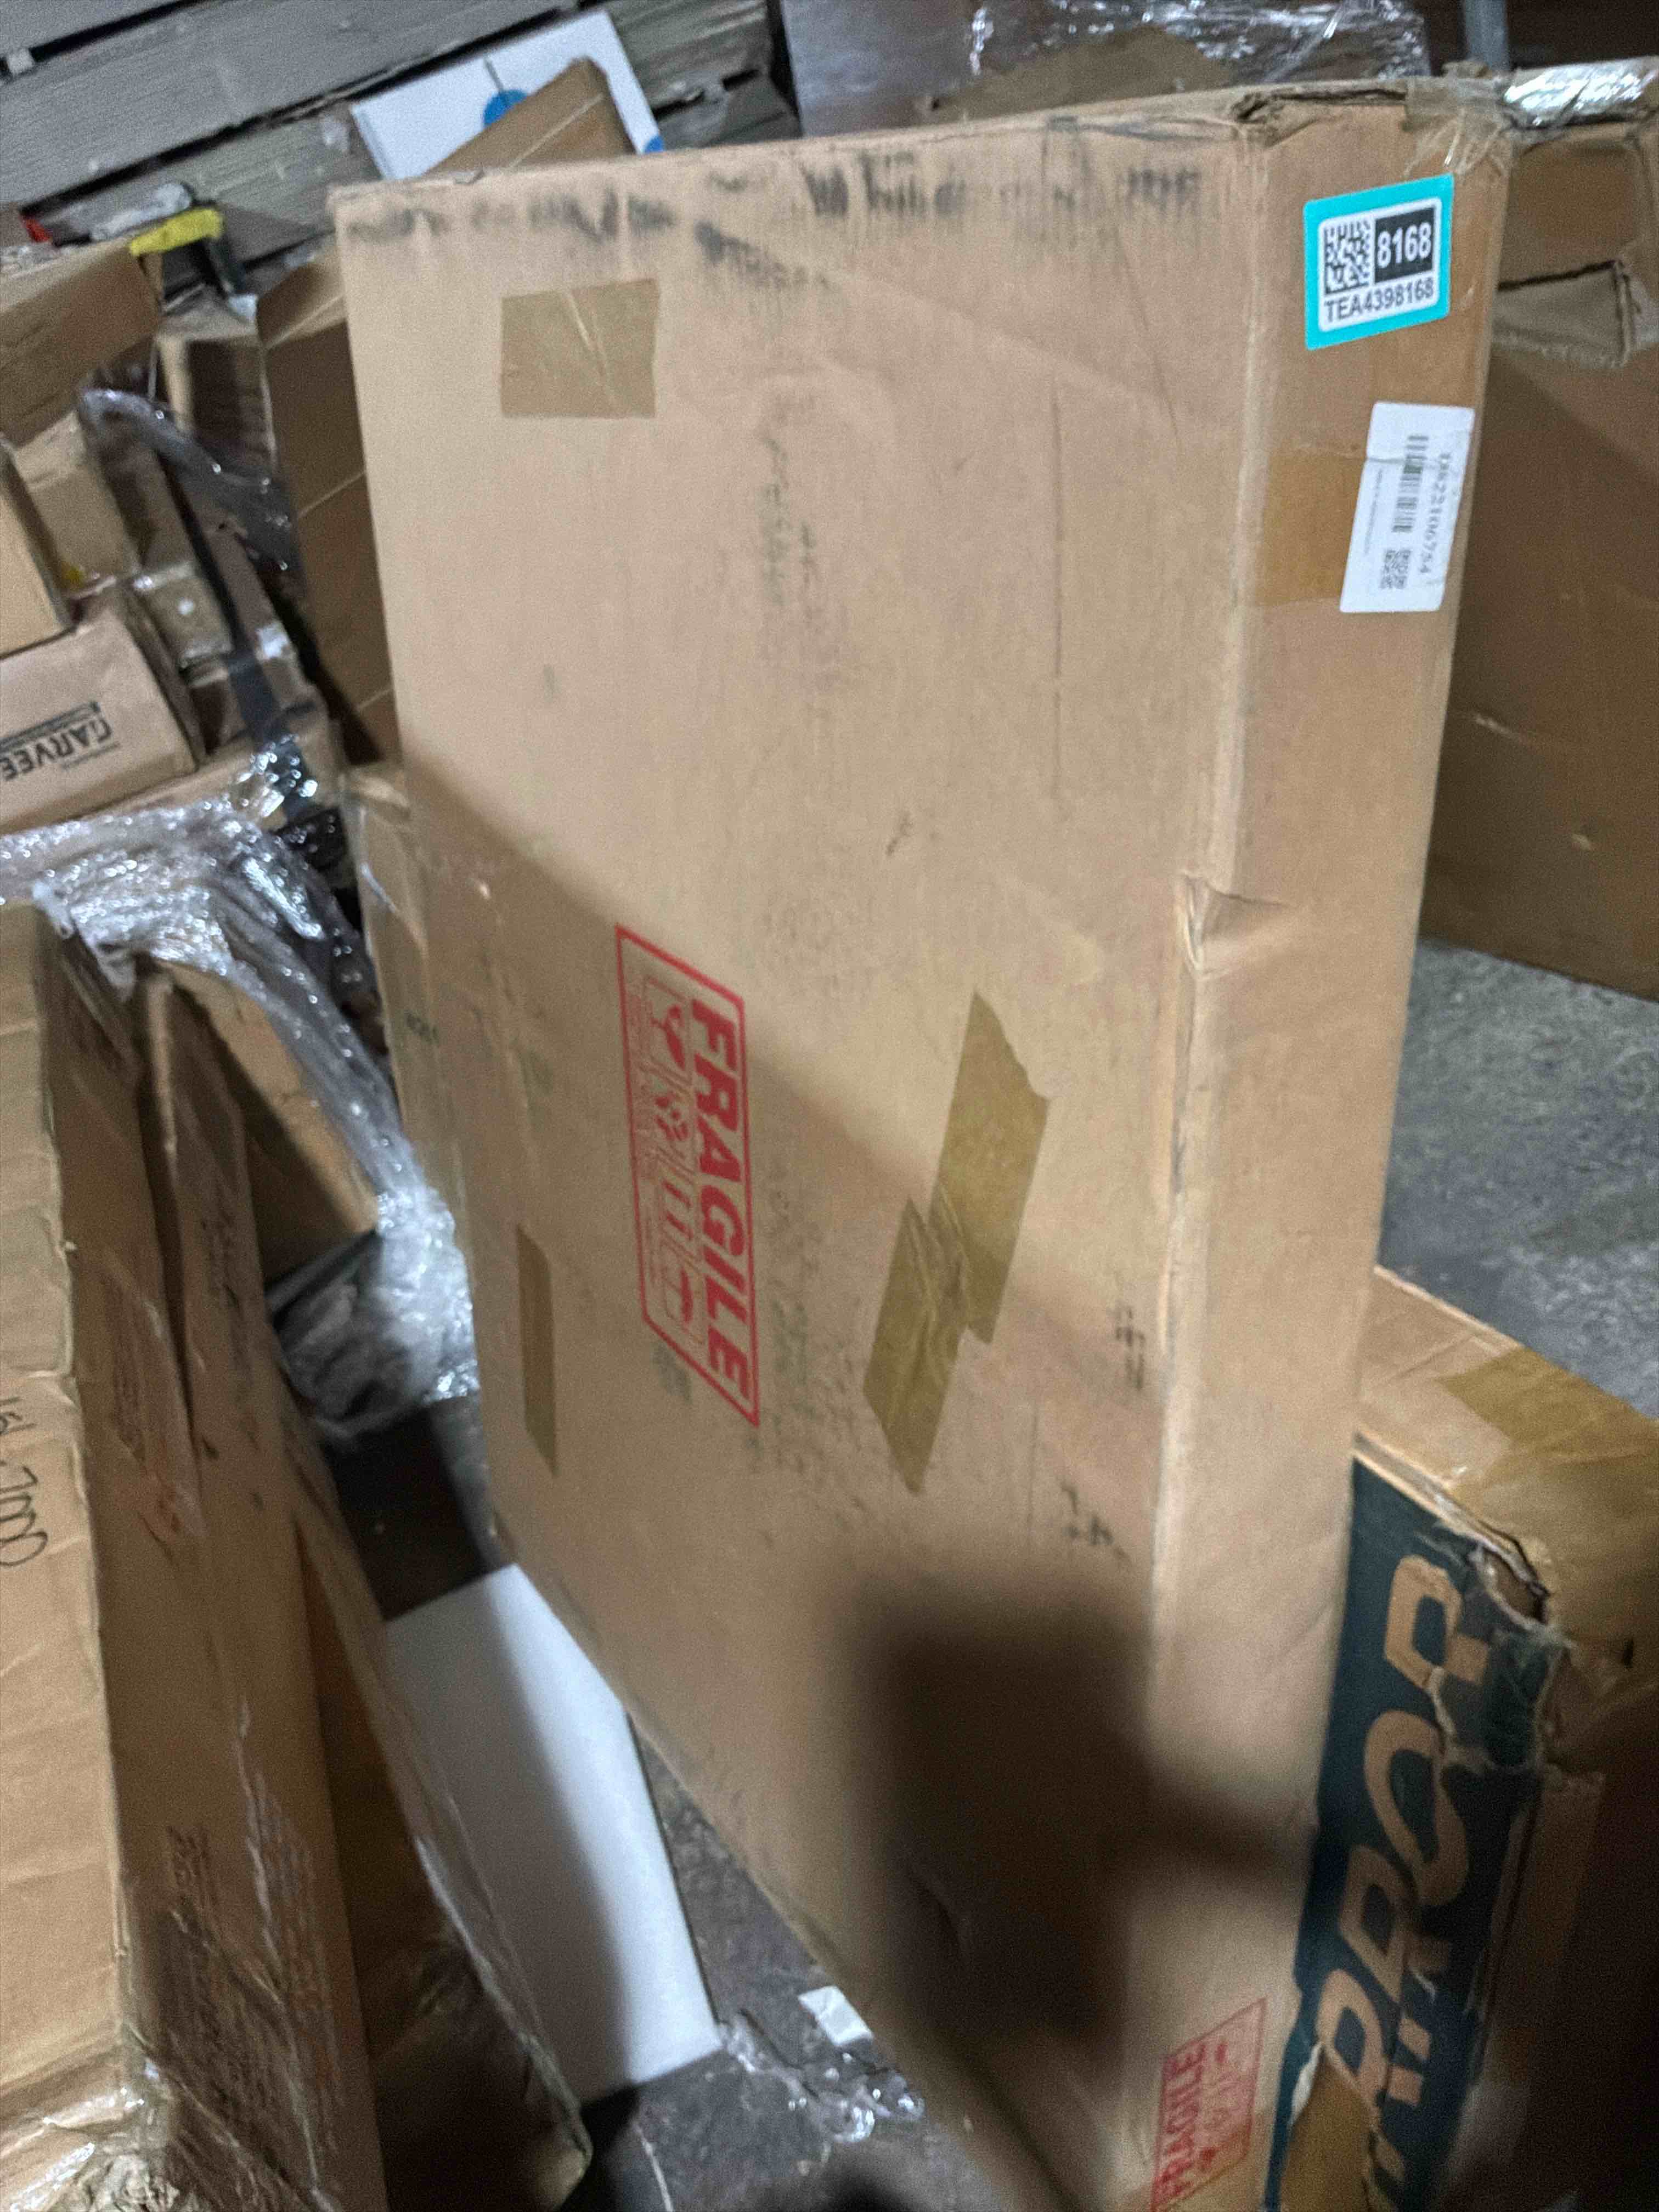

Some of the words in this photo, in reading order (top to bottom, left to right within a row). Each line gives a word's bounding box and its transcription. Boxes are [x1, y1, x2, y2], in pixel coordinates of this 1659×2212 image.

[1377, 222, 1431, 268] 8168
[1325, 277, 1434, 322] TEA4398168
[692, 998, 751, 1399] FRAGILE
